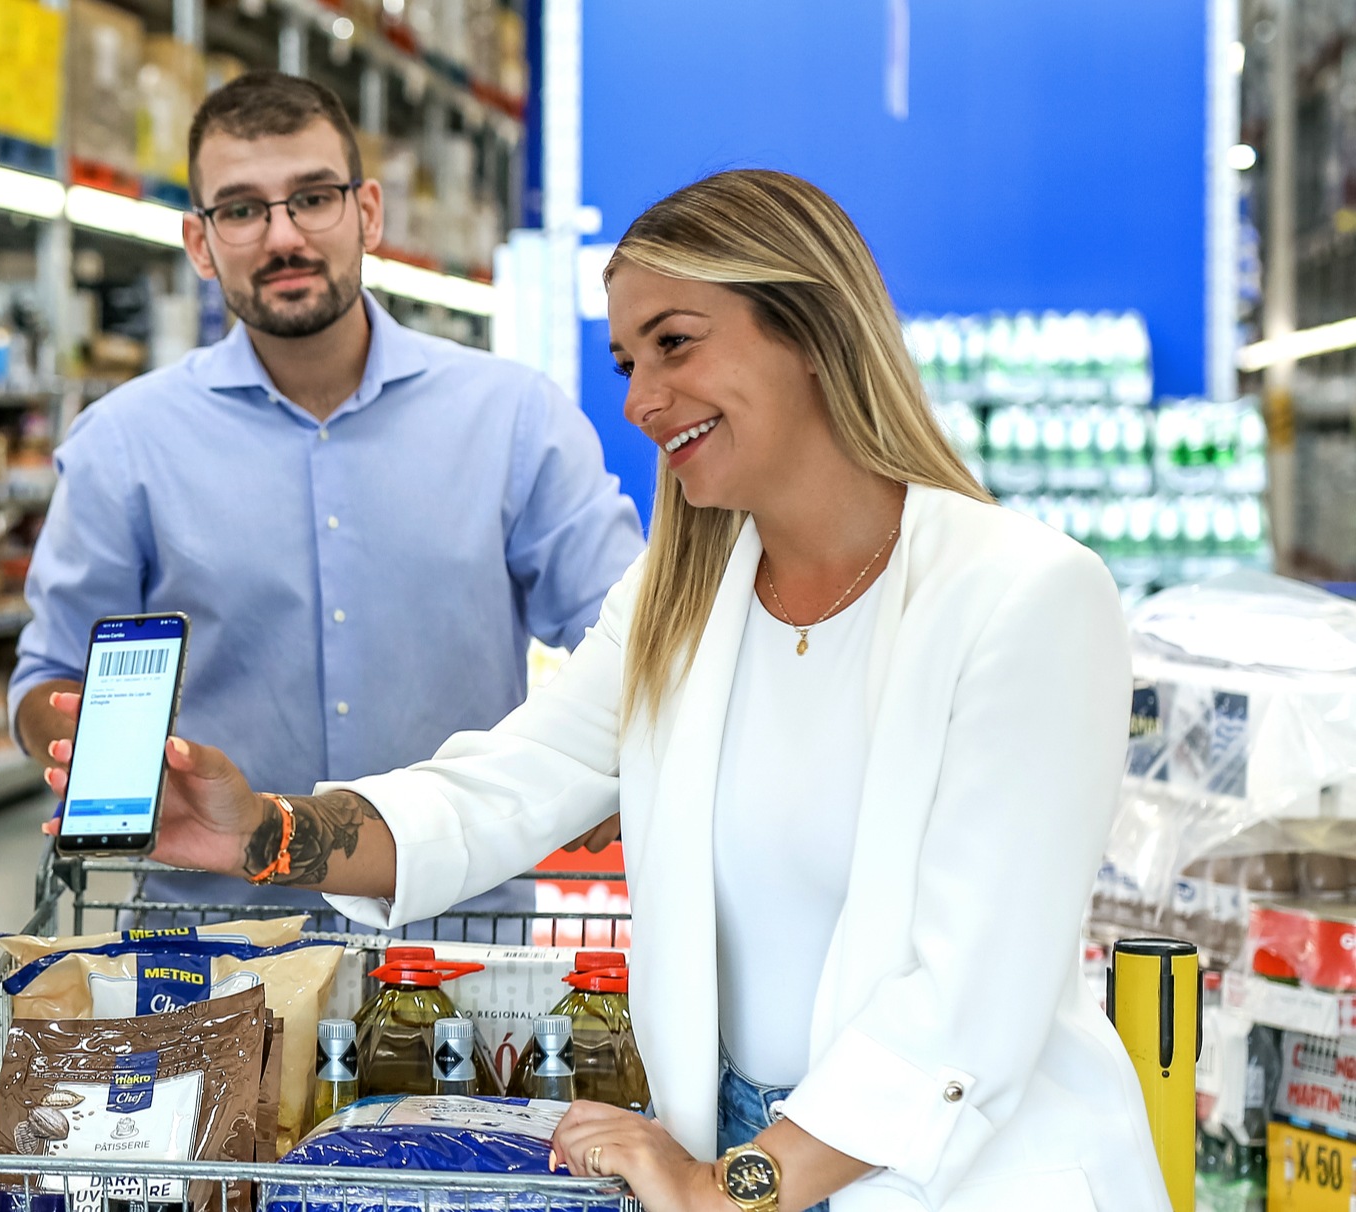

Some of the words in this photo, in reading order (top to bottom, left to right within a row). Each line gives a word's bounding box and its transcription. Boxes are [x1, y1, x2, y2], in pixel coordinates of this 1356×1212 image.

[129, 927, 190, 940] METRO
[144, 968, 204, 985] METRO
[477, 1010, 533, 1019] REGIONAL
[115, 1074, 151, 1085] makro
[116, 1091, 146, 1105] Chef
[94, 1140, 151, 1152] PÂTISSERIE
[1316, 1145, 1343, 1192] 50
[90, 1174, 139, 1188] DARK
